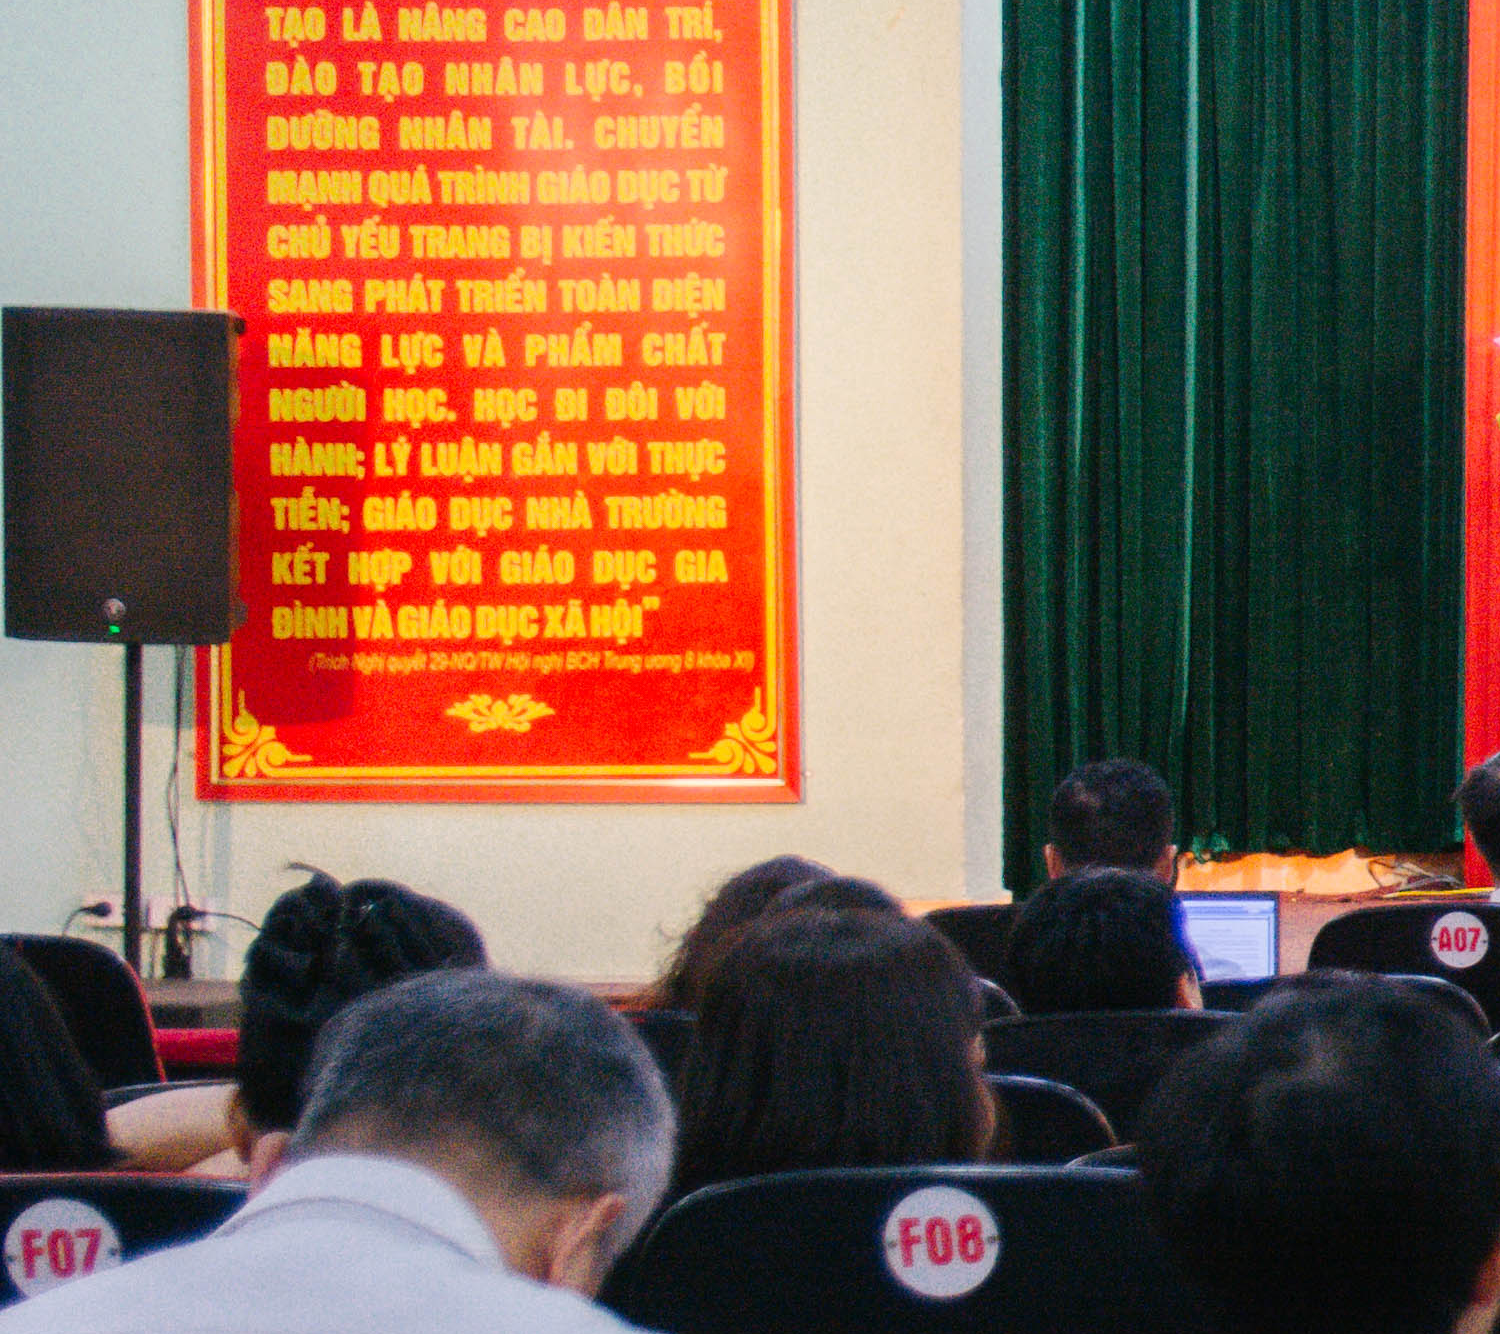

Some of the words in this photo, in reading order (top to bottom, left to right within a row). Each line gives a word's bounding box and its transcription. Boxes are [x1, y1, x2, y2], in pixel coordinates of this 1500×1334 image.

[267, 7, 325, 47] TẠO
[342, 2, 382, 41] LÀ
[398, 2, 486, 42] NÂNG
[504, 9, 565, 41] CAO
[582, 0, 647, 40] DÂN
[664, 0, 723, 42] TRÍ,
[267, 279, 353, 314] SANG
[364, 273, 446, 314] PHÁT
[455, 268, 548, 314] TRIỂN
[558, 273, 641, 313] TOÀN
[652, 272, 727, 318] DIỆN
[273, 543, 329, 584] KẾT
[348, 548, 412, 590] HỢP
[429, 545, 482, 586] VỚI
[498, 543, 576, 586] GIÁO
[592, 549, 656, 590] DỤC
[672, 548, 730, 585] GIA
[1438, 926, 1481, 952] A07
[22, 1229, 100, 1278] F07
[899, 1215, 985, 1267] F08
